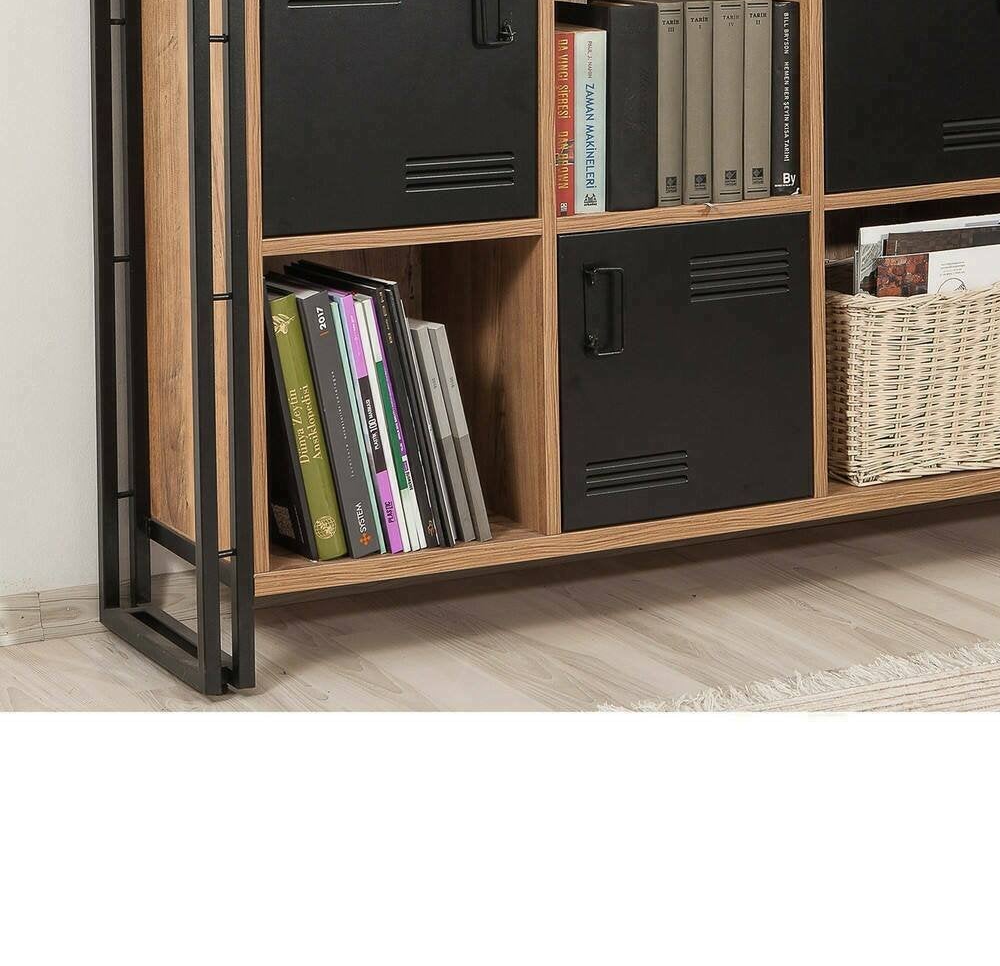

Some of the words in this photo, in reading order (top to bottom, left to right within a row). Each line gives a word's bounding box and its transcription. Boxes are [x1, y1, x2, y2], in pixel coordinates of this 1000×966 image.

[558, 38, 569, 52] DA
[585, 84, 595, 121] ZAMAN
[558, 130, 569, 150] DAN
[558, 154, 569, 190] BROWN
[585, 124, 597, 189] MAKİNELERİ
[783, 172, 796, 186] By
[316, 306, 328, 331] 2017
[288, 388, 303, 426] Zeytin
[300, 384, 323, 460] Ansiklopedisi
[368, 416, 378, 434] 100
[297, 428, 310, 464] Dünya
[355, 502, 368, 534] SYSTEM
[385, 501, 394, 524] PLASTIC
